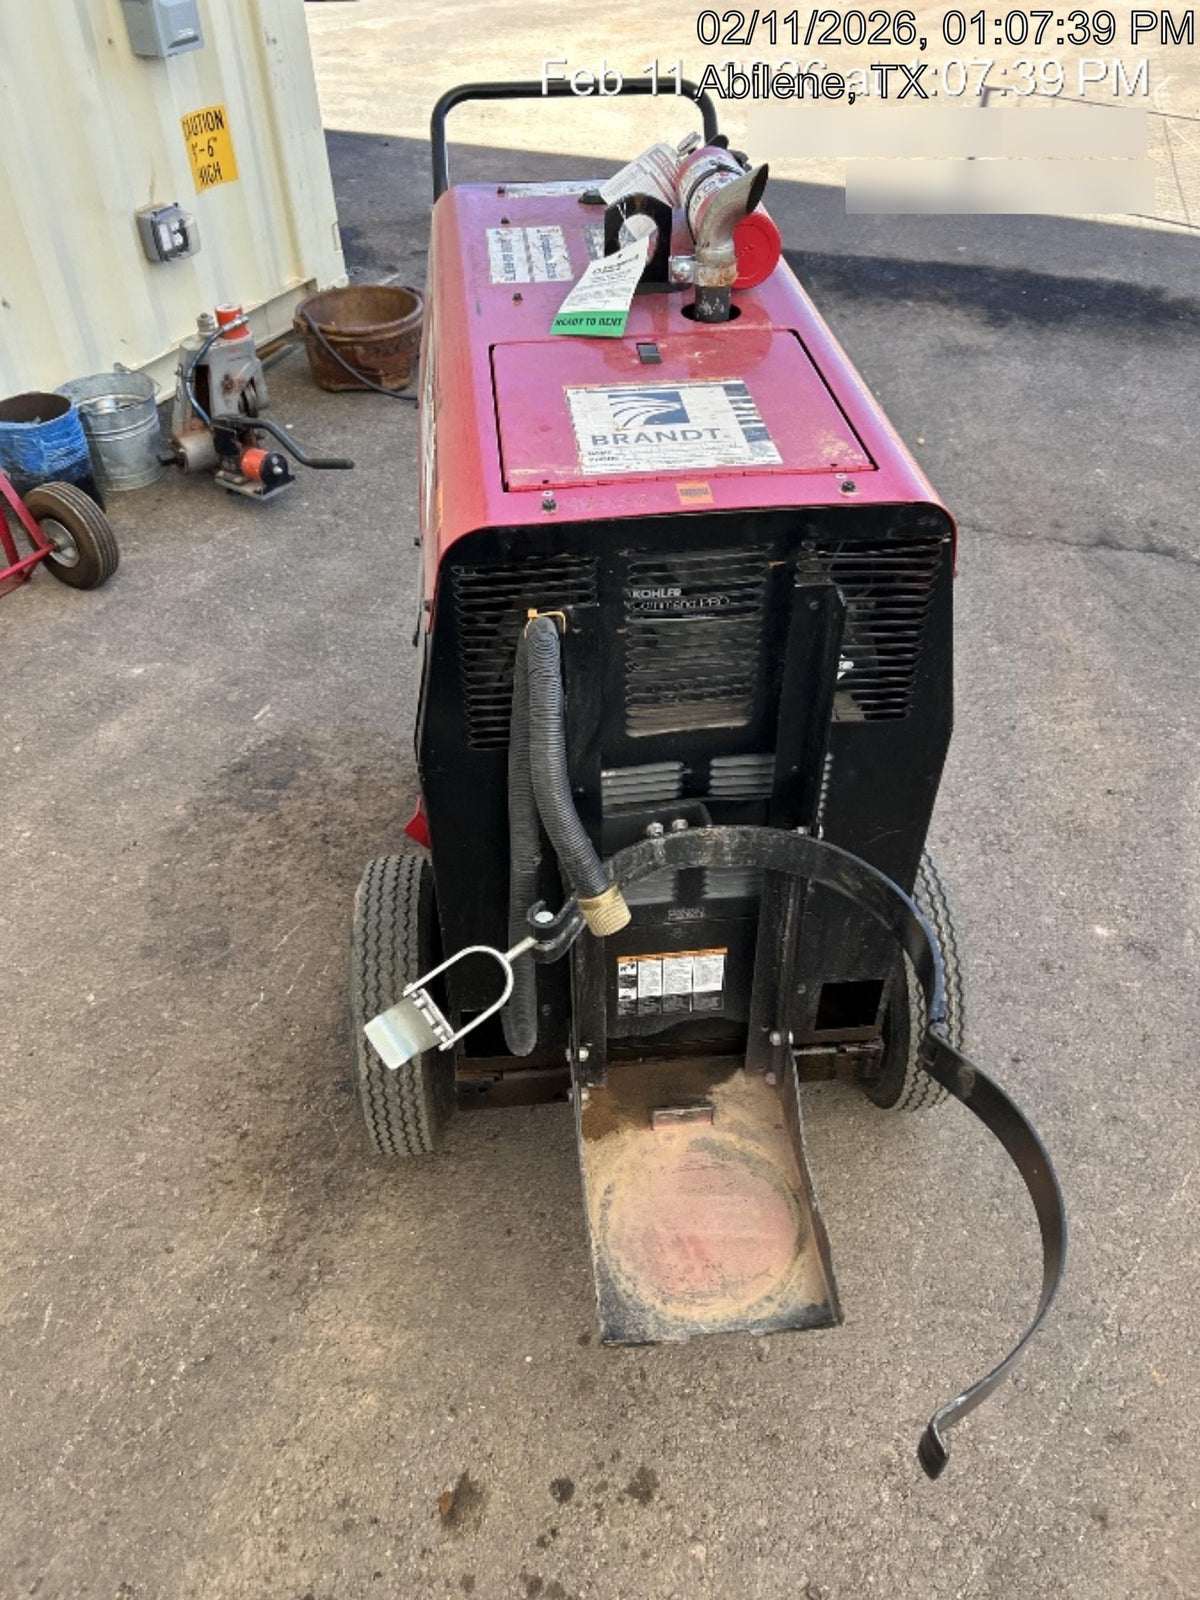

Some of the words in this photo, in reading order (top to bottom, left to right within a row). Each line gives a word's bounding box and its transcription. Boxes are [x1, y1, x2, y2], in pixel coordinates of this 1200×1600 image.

[182, 110, 225, 141] CAUTION
[592, 427, 721, 447] BRANDT
[632, 587, 682, 599] KOHLER
